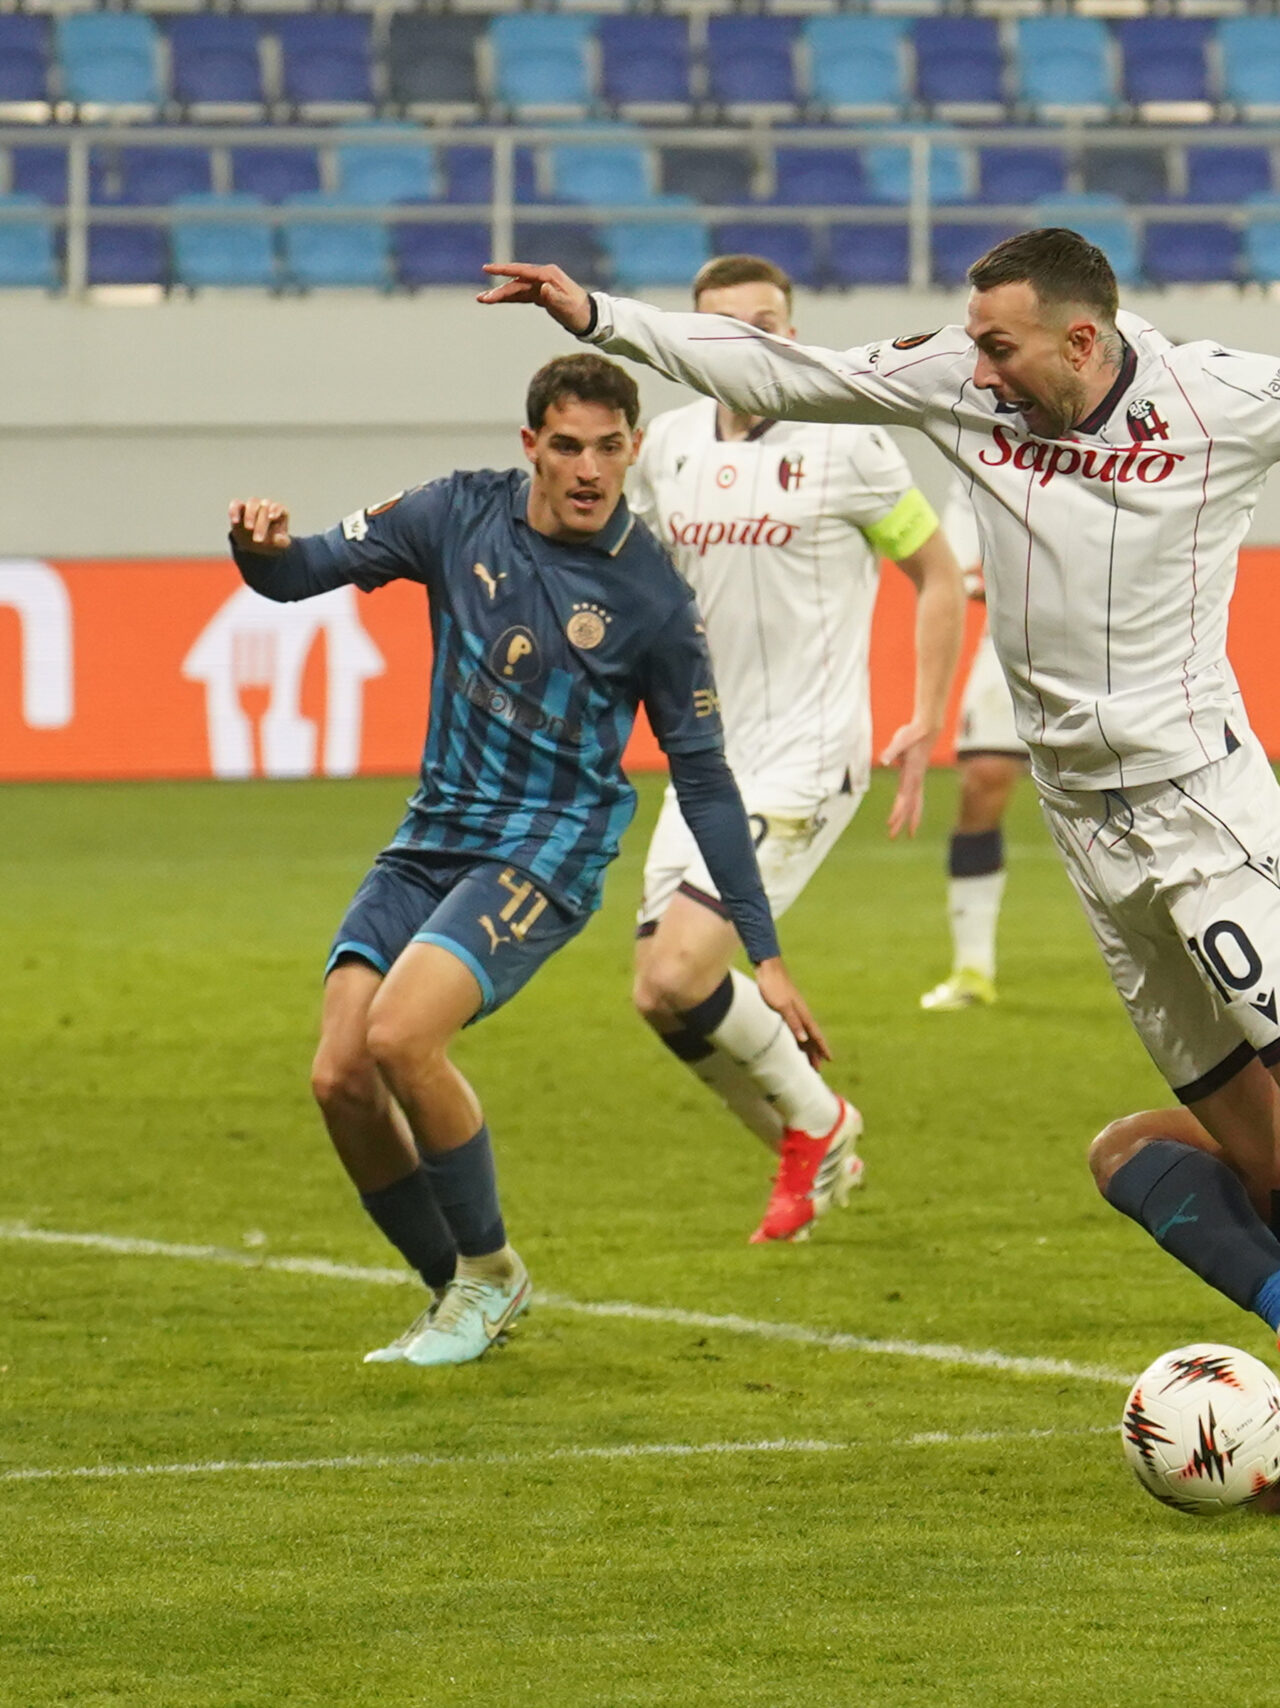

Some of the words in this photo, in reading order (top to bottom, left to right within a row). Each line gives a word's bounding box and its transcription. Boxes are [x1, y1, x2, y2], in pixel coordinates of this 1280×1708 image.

[978, 424, 1186, 488] Saputo
[668, 511, 800, 557] Saputo
[498, 867, 548, 941] 41
[1187, 920, 1263, 1005] 10
